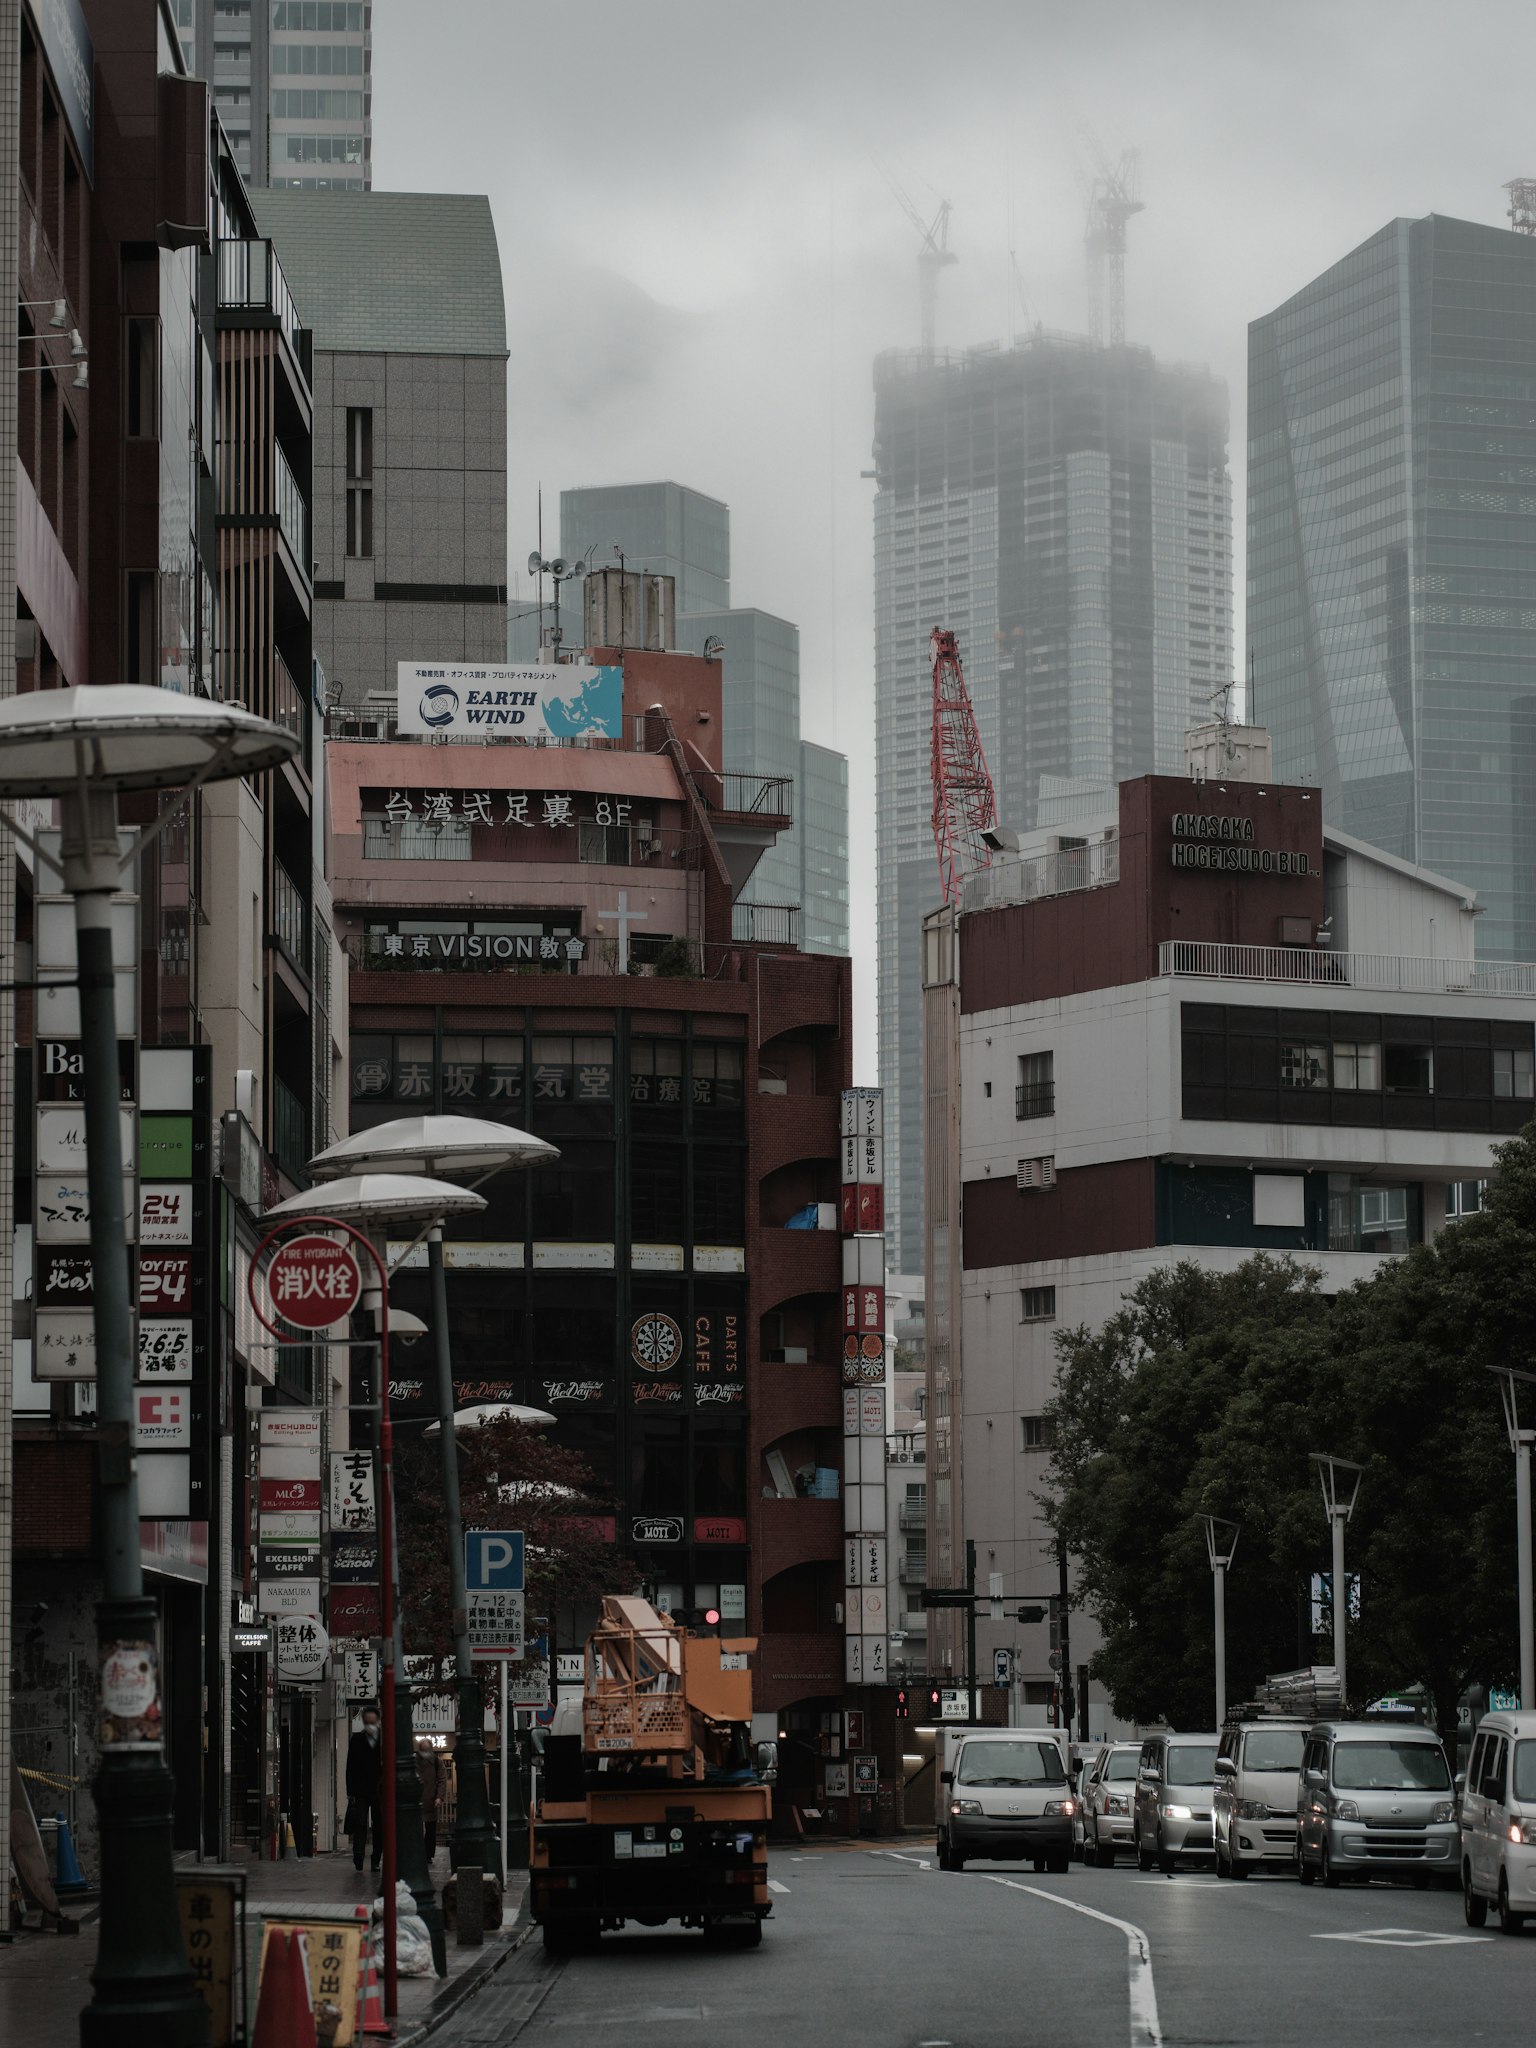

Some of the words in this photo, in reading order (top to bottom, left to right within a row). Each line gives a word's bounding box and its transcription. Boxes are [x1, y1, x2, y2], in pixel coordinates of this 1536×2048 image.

[466, 690, 536, 706] EARTH
[466, 710, 525, 724] WIND
[384, 792, 576, 828] 台湾式足裏
[595, 801, 633, 827] 8F
[1172, 813, 1255, 841] AKASAKA
[1172, 844, 1272, 873] HOGETSUDO
[195, 1076, 207, 1084] 6F
[399, 1065, 612, 1100] 赤坂元気堂
[195, 1143, 206, 1151] 5F
[143, 1195, 181, 1215] 24
[143, 1216, 179, 1225] 時間営業
[283, 1249, 302, 1260] FIRE
[304, 1248, 343, 1260] HYDRANT
[51, 1258, 93, 1268] 札幌らーめ
[140, 1275, 187, 1303] 24
[276, 1264, 353, 1301] 消火栓
[195, 1345, 206, 1353] 2F
[696, 1316, 710, 1372] CAFE
[725, 1316, 738, 1372] DARTS
[146, 1355, 176, 1372] 酒場
[137, 1427, 183, 1435] ココカラファイン
[192, 1480, 203, 1489] B1
[343, 1453, 374, 1529] 吉そば
[644, 1527, 670, 1540] MOTI
[706, 1527, 731, 1539] MOTI
[265, 1555, 314, 1563] EXCELSIOR
[333, 1558, 376, 1569] School
[481, 1538, 512, 1584] P
[275, 1562, 305, 1572] CAFFÉ
[267, 1588, 312, 1596] NAKAMURA
[281, 1598, 298, 1606] BLD
[469, 1607, 522, 1618] 貨物集配中の
[469, 1619, 522, 1630] 貨物車に限る
[279, 1624, 317, 1644] 整体
[354, 1652, 373, 1698] 吉そば
